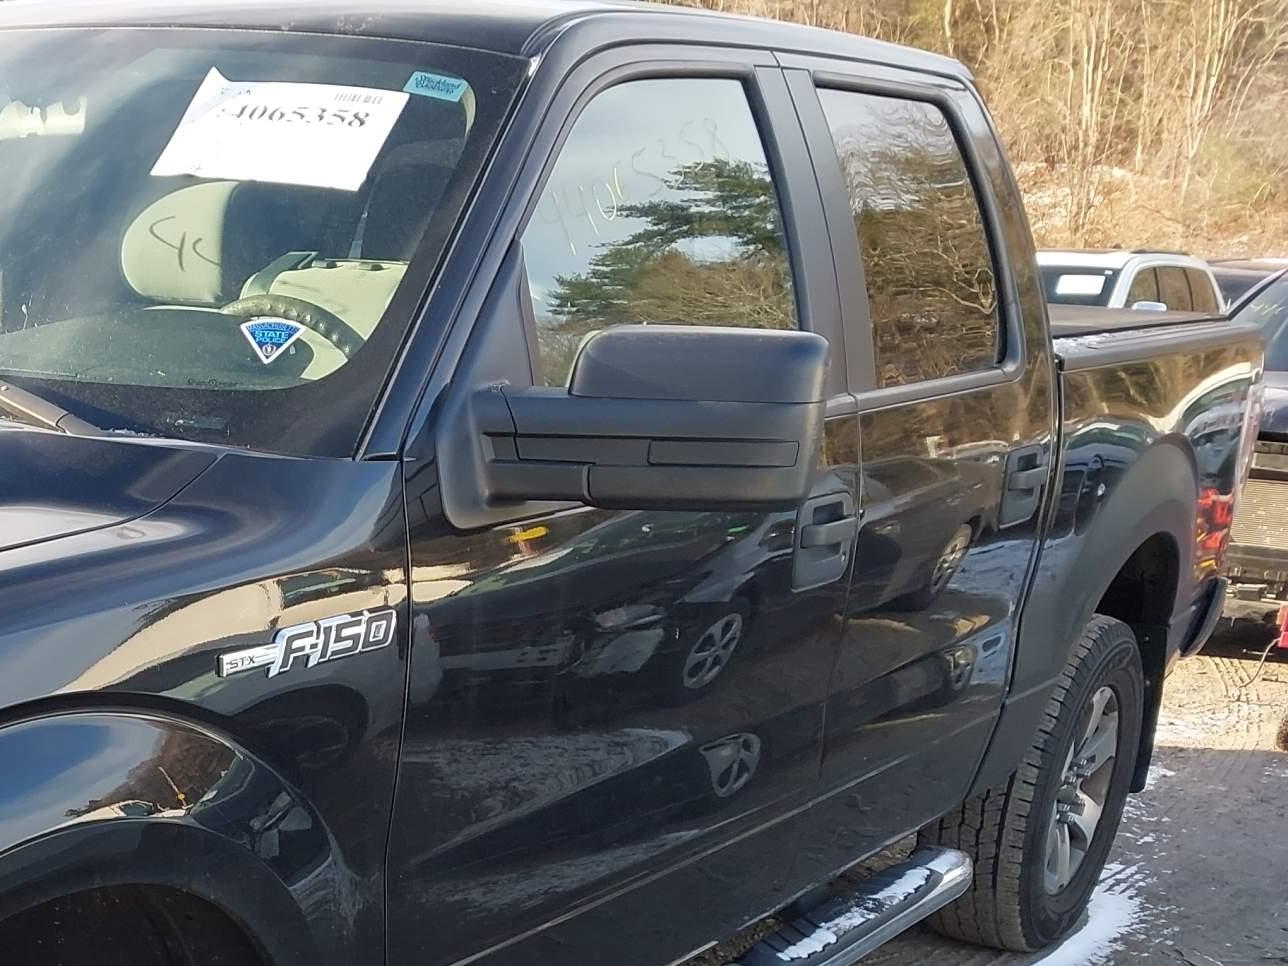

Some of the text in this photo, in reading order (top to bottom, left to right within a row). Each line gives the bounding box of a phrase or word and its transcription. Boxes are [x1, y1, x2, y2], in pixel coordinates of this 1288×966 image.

[218, 102, 372, 128] 4065358
[254, 330, 289, 339] STATE
[226, 653, 256, 670] STX
